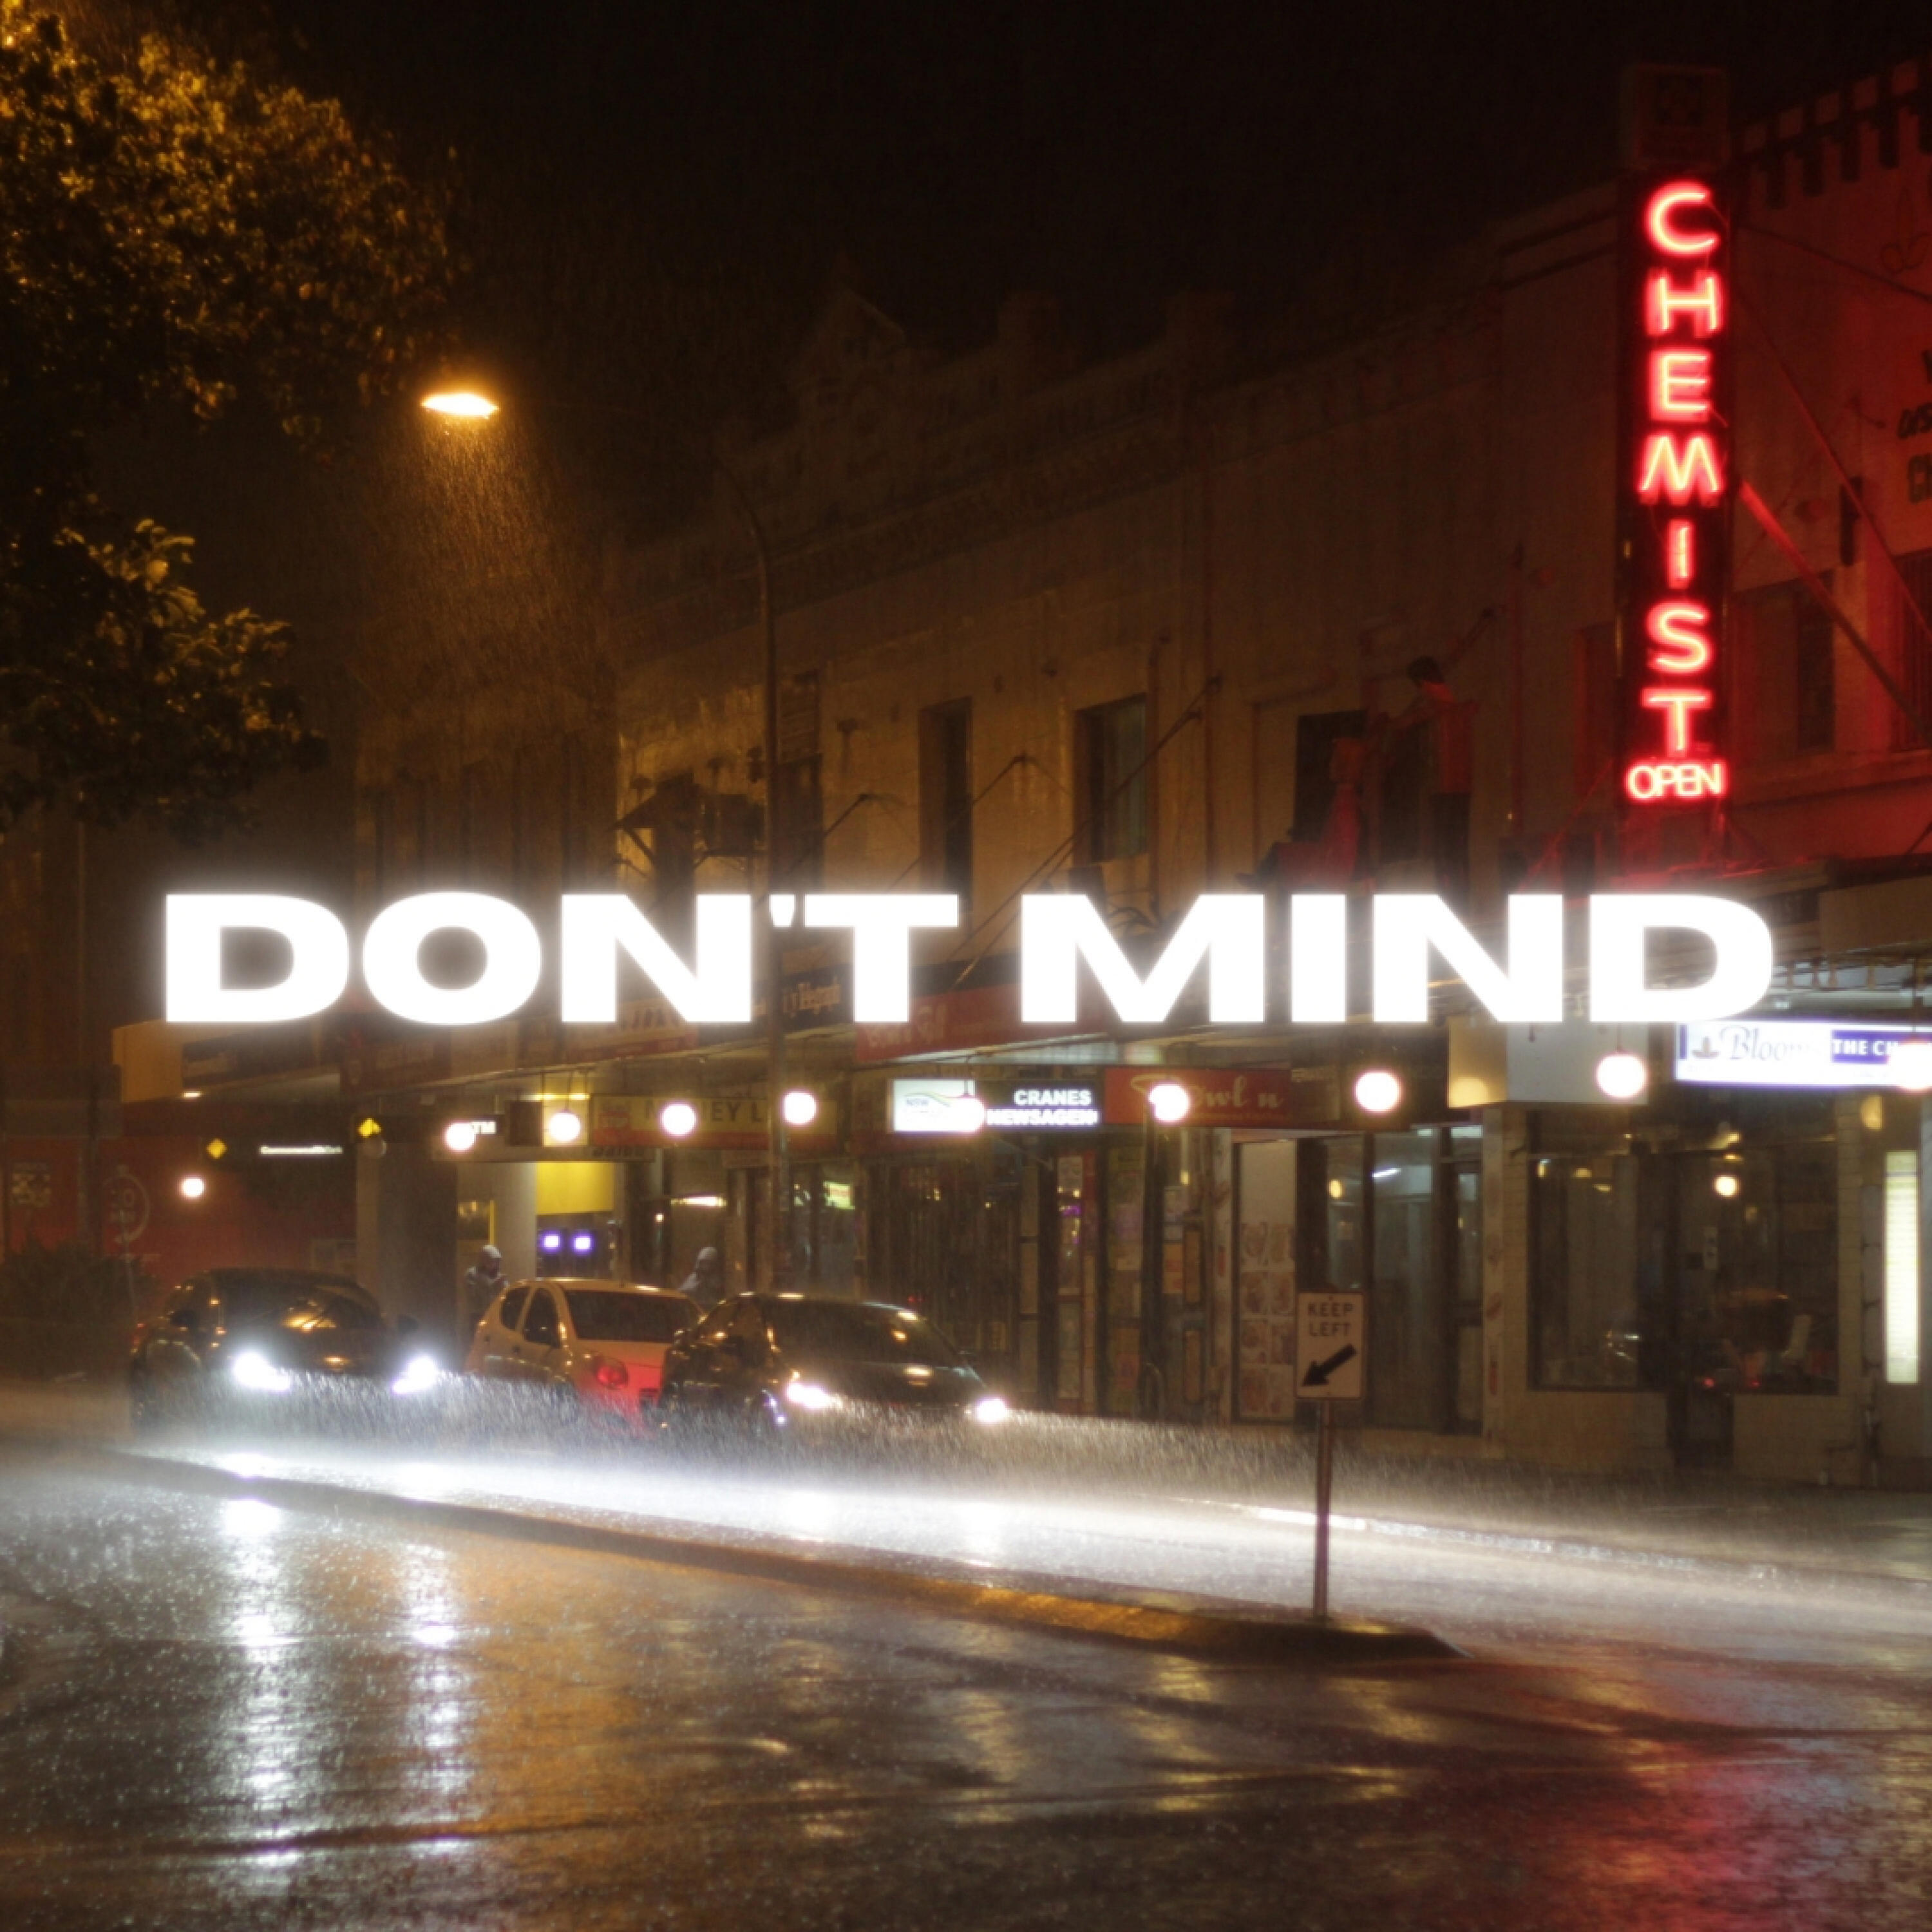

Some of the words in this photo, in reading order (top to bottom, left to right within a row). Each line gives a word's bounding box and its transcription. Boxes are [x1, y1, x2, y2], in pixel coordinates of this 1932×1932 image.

[1640, 180, 1725, 756] CHEMIST
[1625, 761, 1728, 804] OPEN
[1014, 1089, 1092, 1106] CRANES
[1307, 1302, 1355, 1317] KEEP
[1309, 1322, 1351, 1336] LEFT
